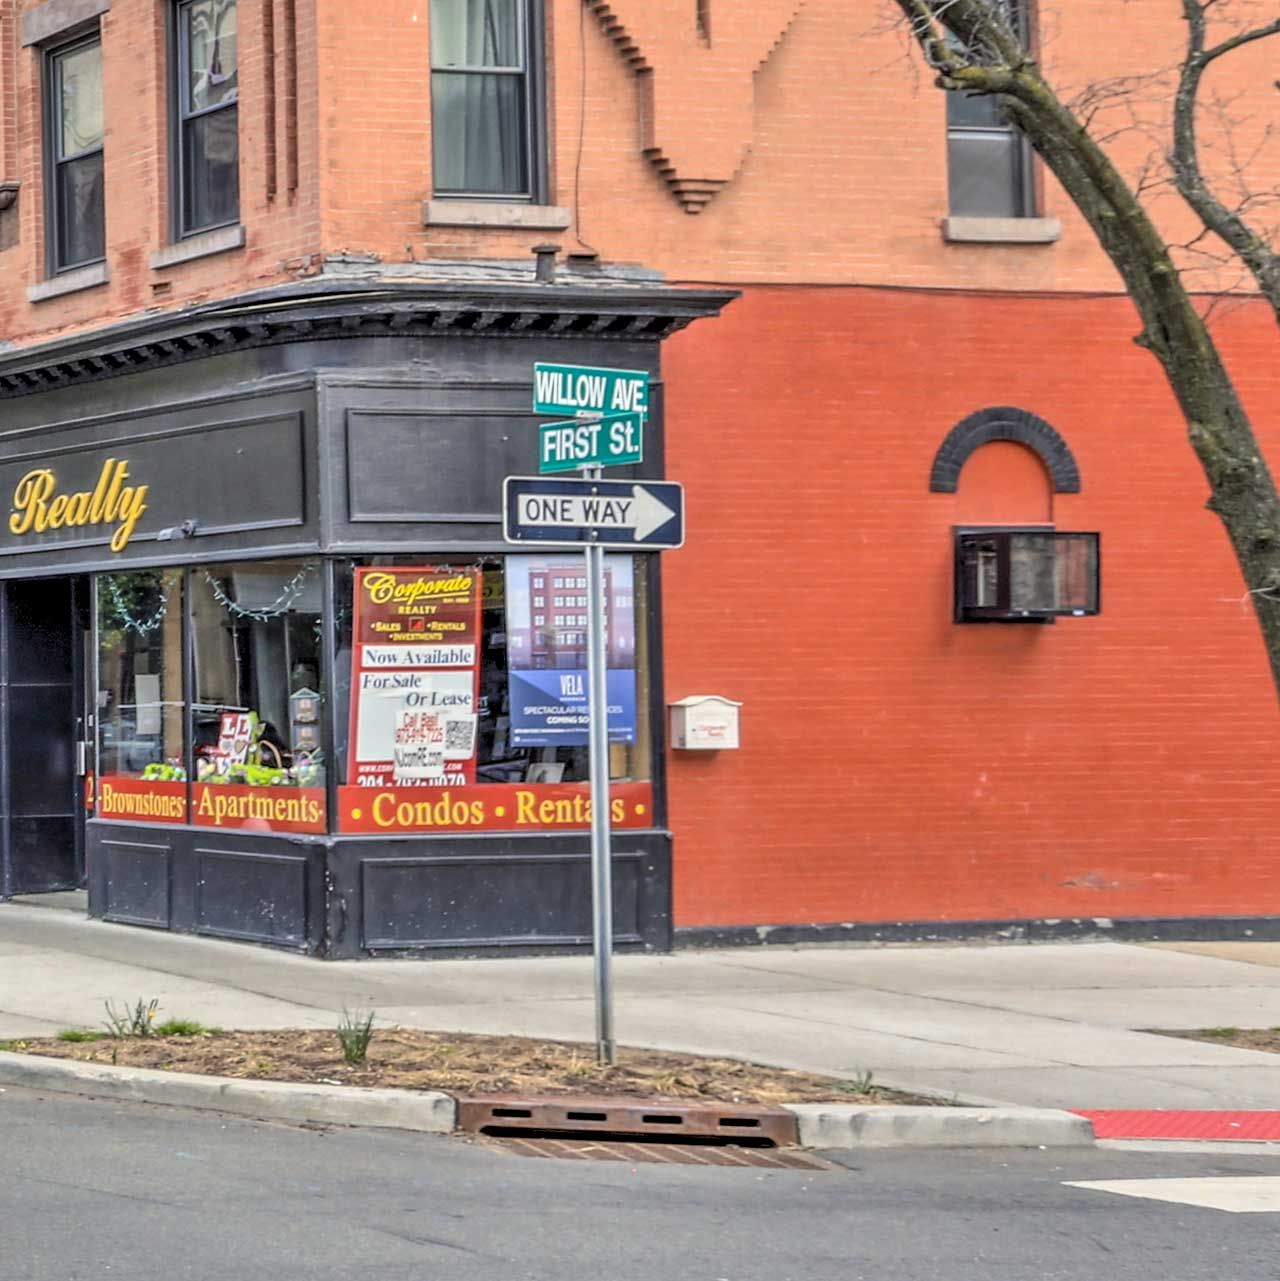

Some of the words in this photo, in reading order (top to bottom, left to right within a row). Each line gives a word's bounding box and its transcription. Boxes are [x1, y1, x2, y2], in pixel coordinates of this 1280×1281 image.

[536, 370, 606, 408] WILLOW
[611, 378, 648, 412] AVE.
[543, 424, 601, 462] FIRST
[609, 420, 639, 455] St.
[9, 458, 149, 553] Realty
[526, 498, 572, 522] ONE
[582, 500, 631, 524] WAY
[363, 572, 473, 606] Corporate
[398, 605, 438, 615] REALTY
[365, 649, 398, 665] Now
[404, 648, 471, 665] Available
[363, 674, 390, 689] For
[391, 673, 422, 689] Sale
[560, 675, 584, 696] VELA
[406, 691, 428, 706] Or
[431, 691, 472, 706] Lease
[102, 783, 184, 818] Brownstones
[198, 786, 319, 825] Apartments
[372, 791, 484, 827] Condos
[515, 790, 625, 825] Rentas
